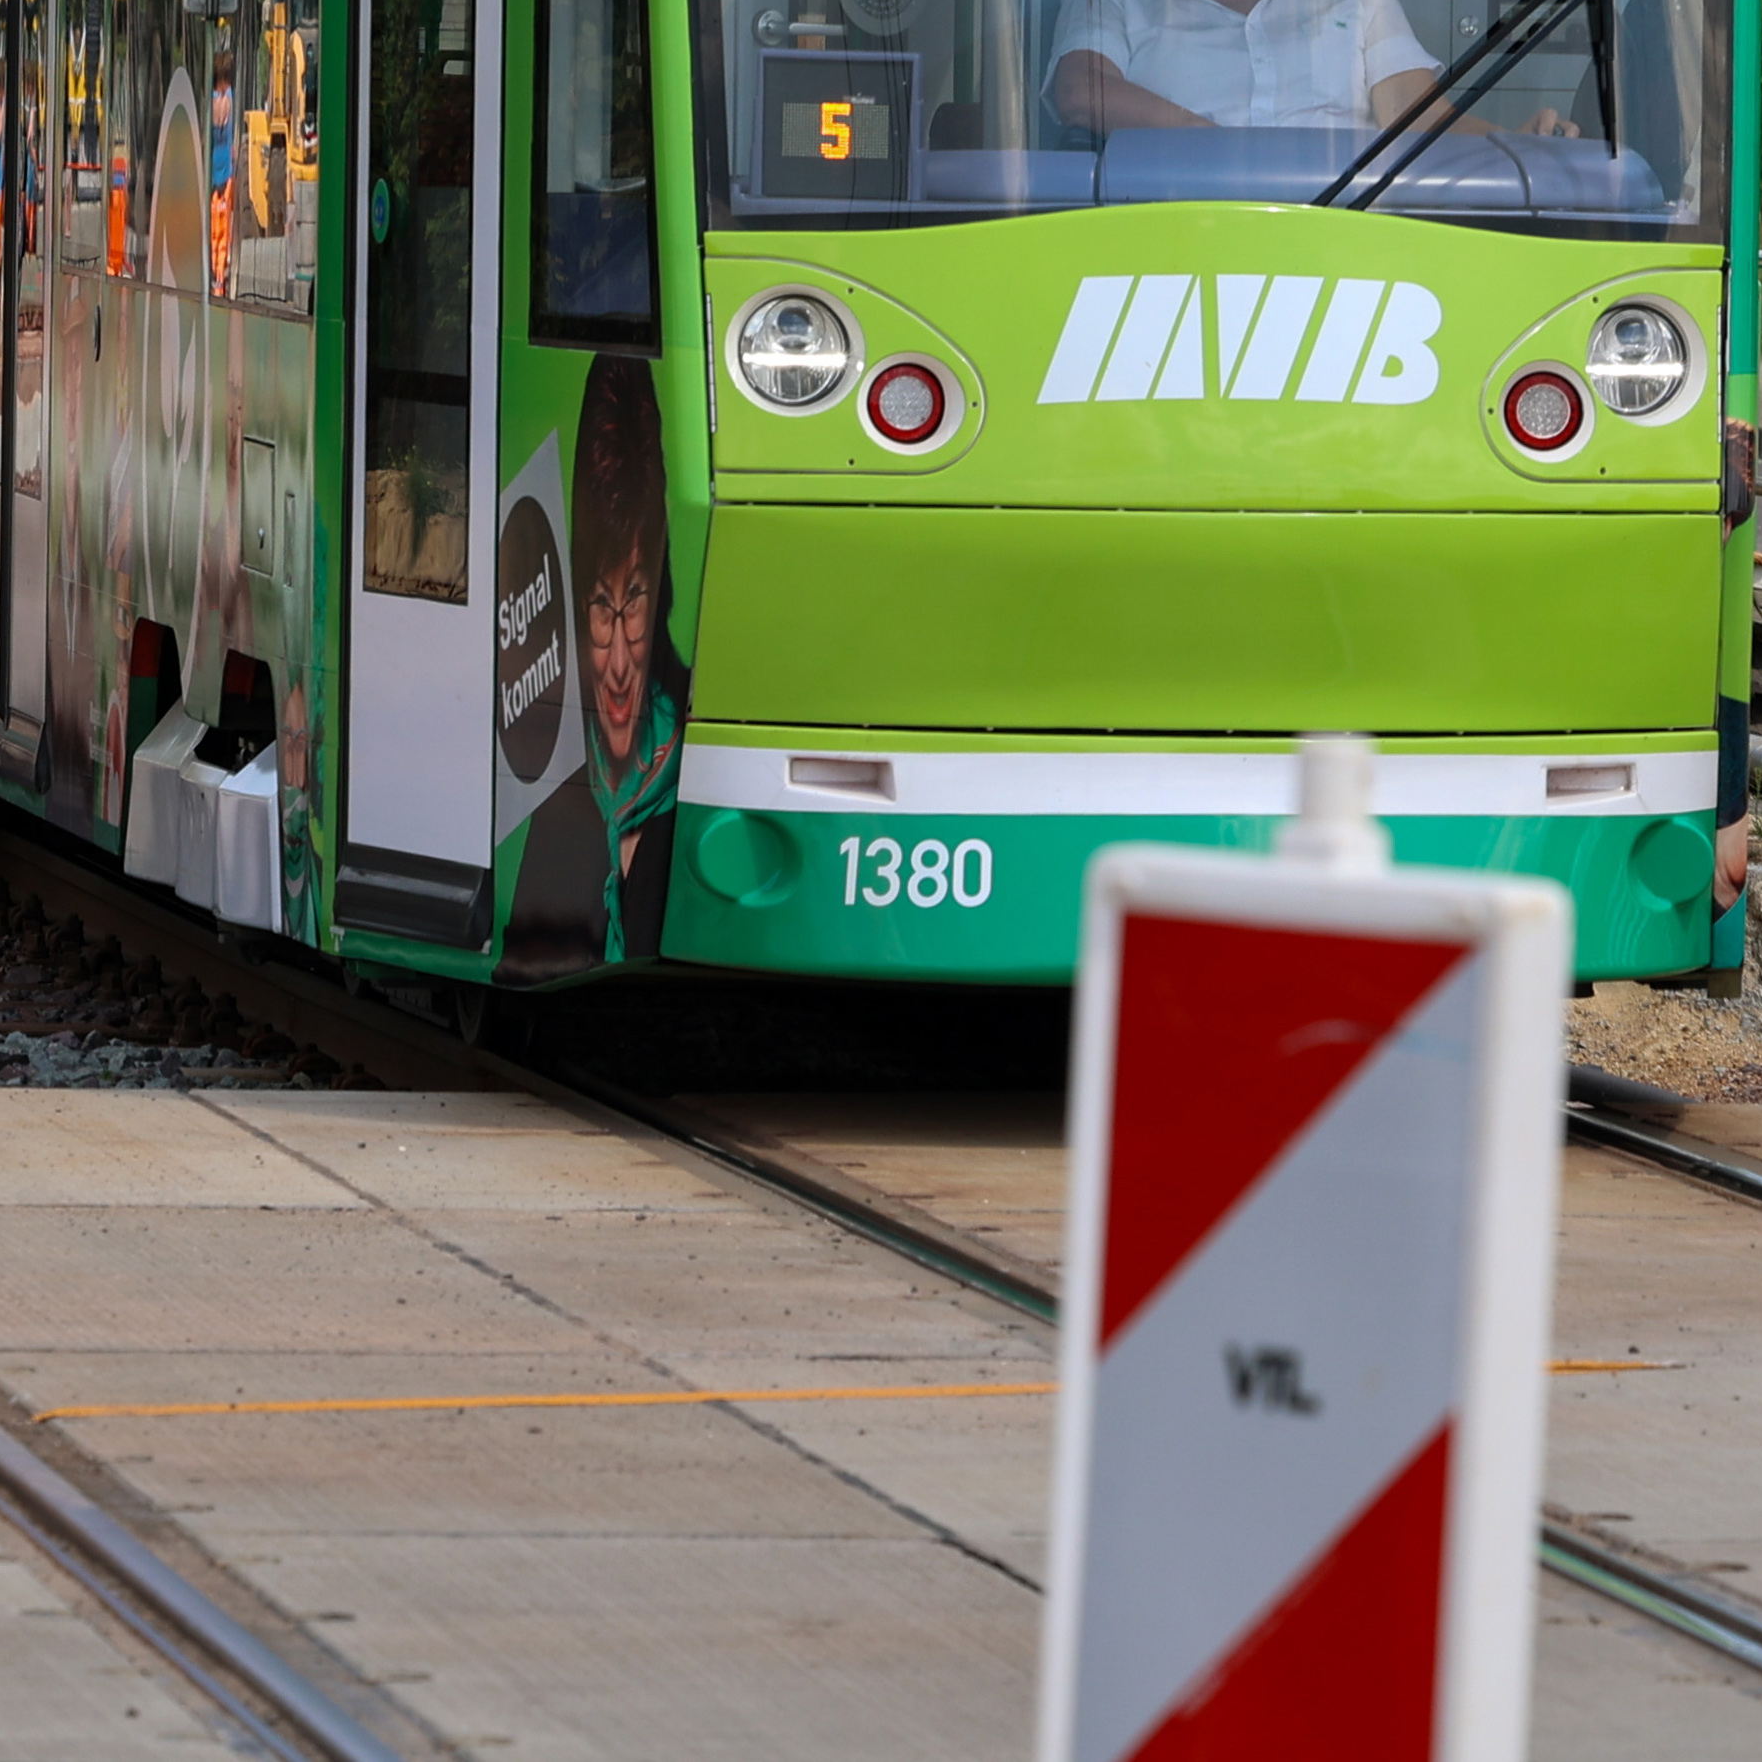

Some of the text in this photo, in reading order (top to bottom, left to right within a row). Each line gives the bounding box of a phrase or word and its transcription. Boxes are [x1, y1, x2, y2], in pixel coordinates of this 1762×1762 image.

[820, 101, 852, 160] 5
[1037, 272, 1440, 405] MVB
[498, 552, 552, 651] Signal
[500, 628, 562, 730] kommt
[838, 835, 994, 909] 1380
[1220, 1340, 1324, 1418] VTL
